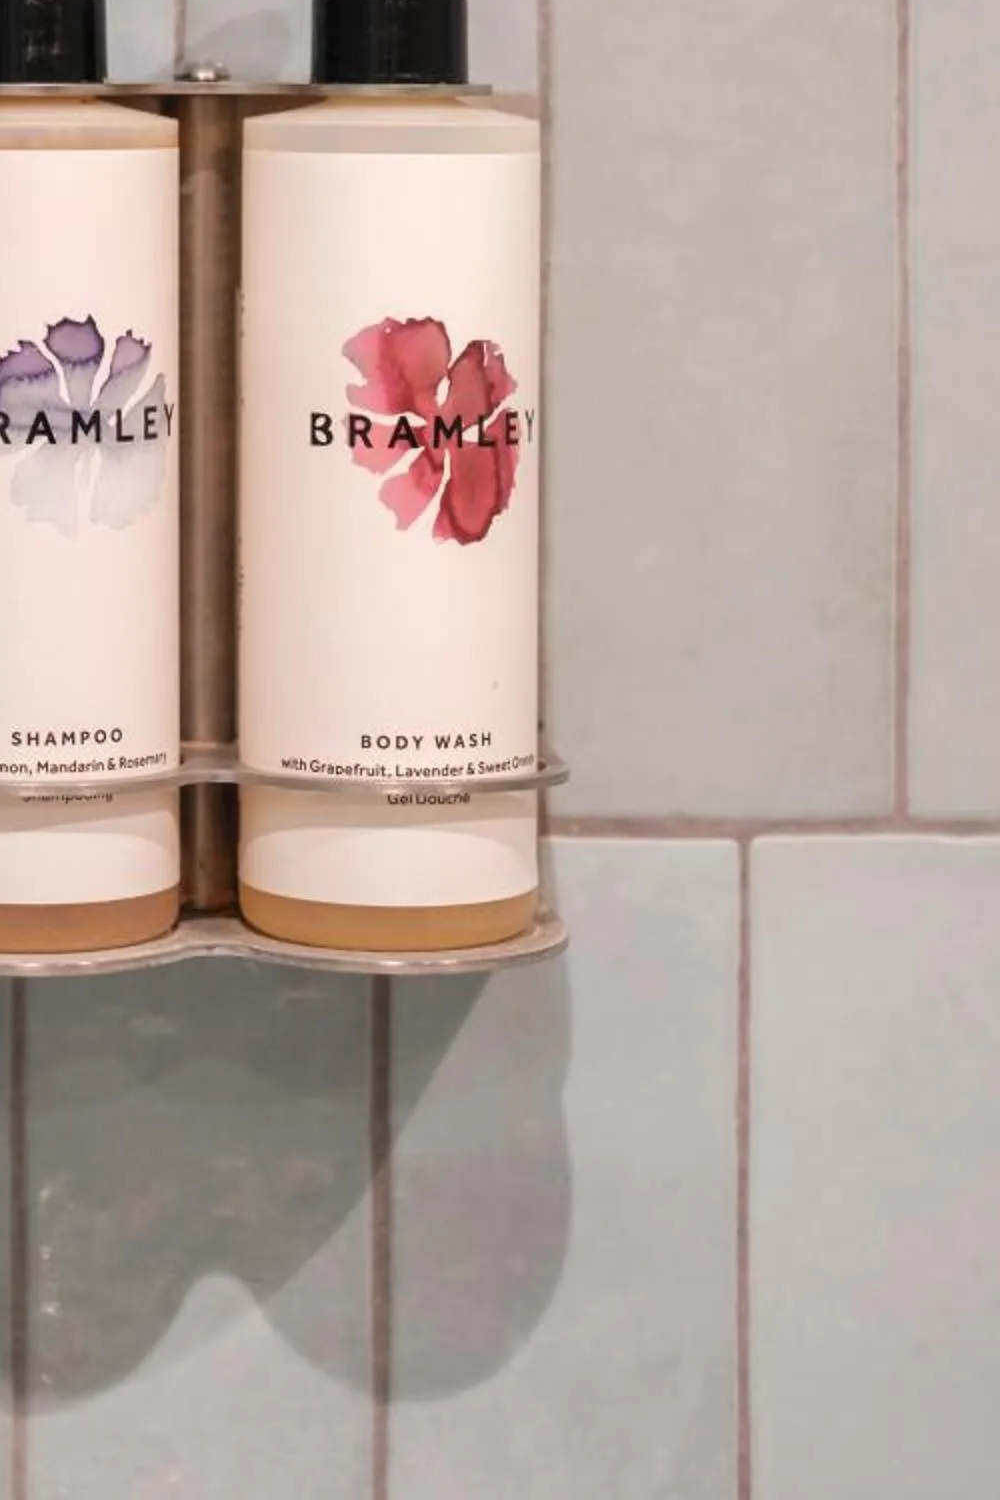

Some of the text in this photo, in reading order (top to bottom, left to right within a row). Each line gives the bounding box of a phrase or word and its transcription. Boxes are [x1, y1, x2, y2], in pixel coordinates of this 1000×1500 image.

[310, 407, 536, 449] BRAMLEY
[11, 727, 124, 747] SHAMPOO
[361, 731, 492, 750] BODY WASH
[36, 758, 105, 774] Mandarin
[107, 757, 116, 771] &
[281, 756, 307, 771] with
[309, 759, 393, 779] Grapefruit,
[395, 765, 464, 779] Lavender
[466, 761, 475, 775] &
[477, 760, 511, 775] Sweet
[387, 793, 413, 806] Gel
